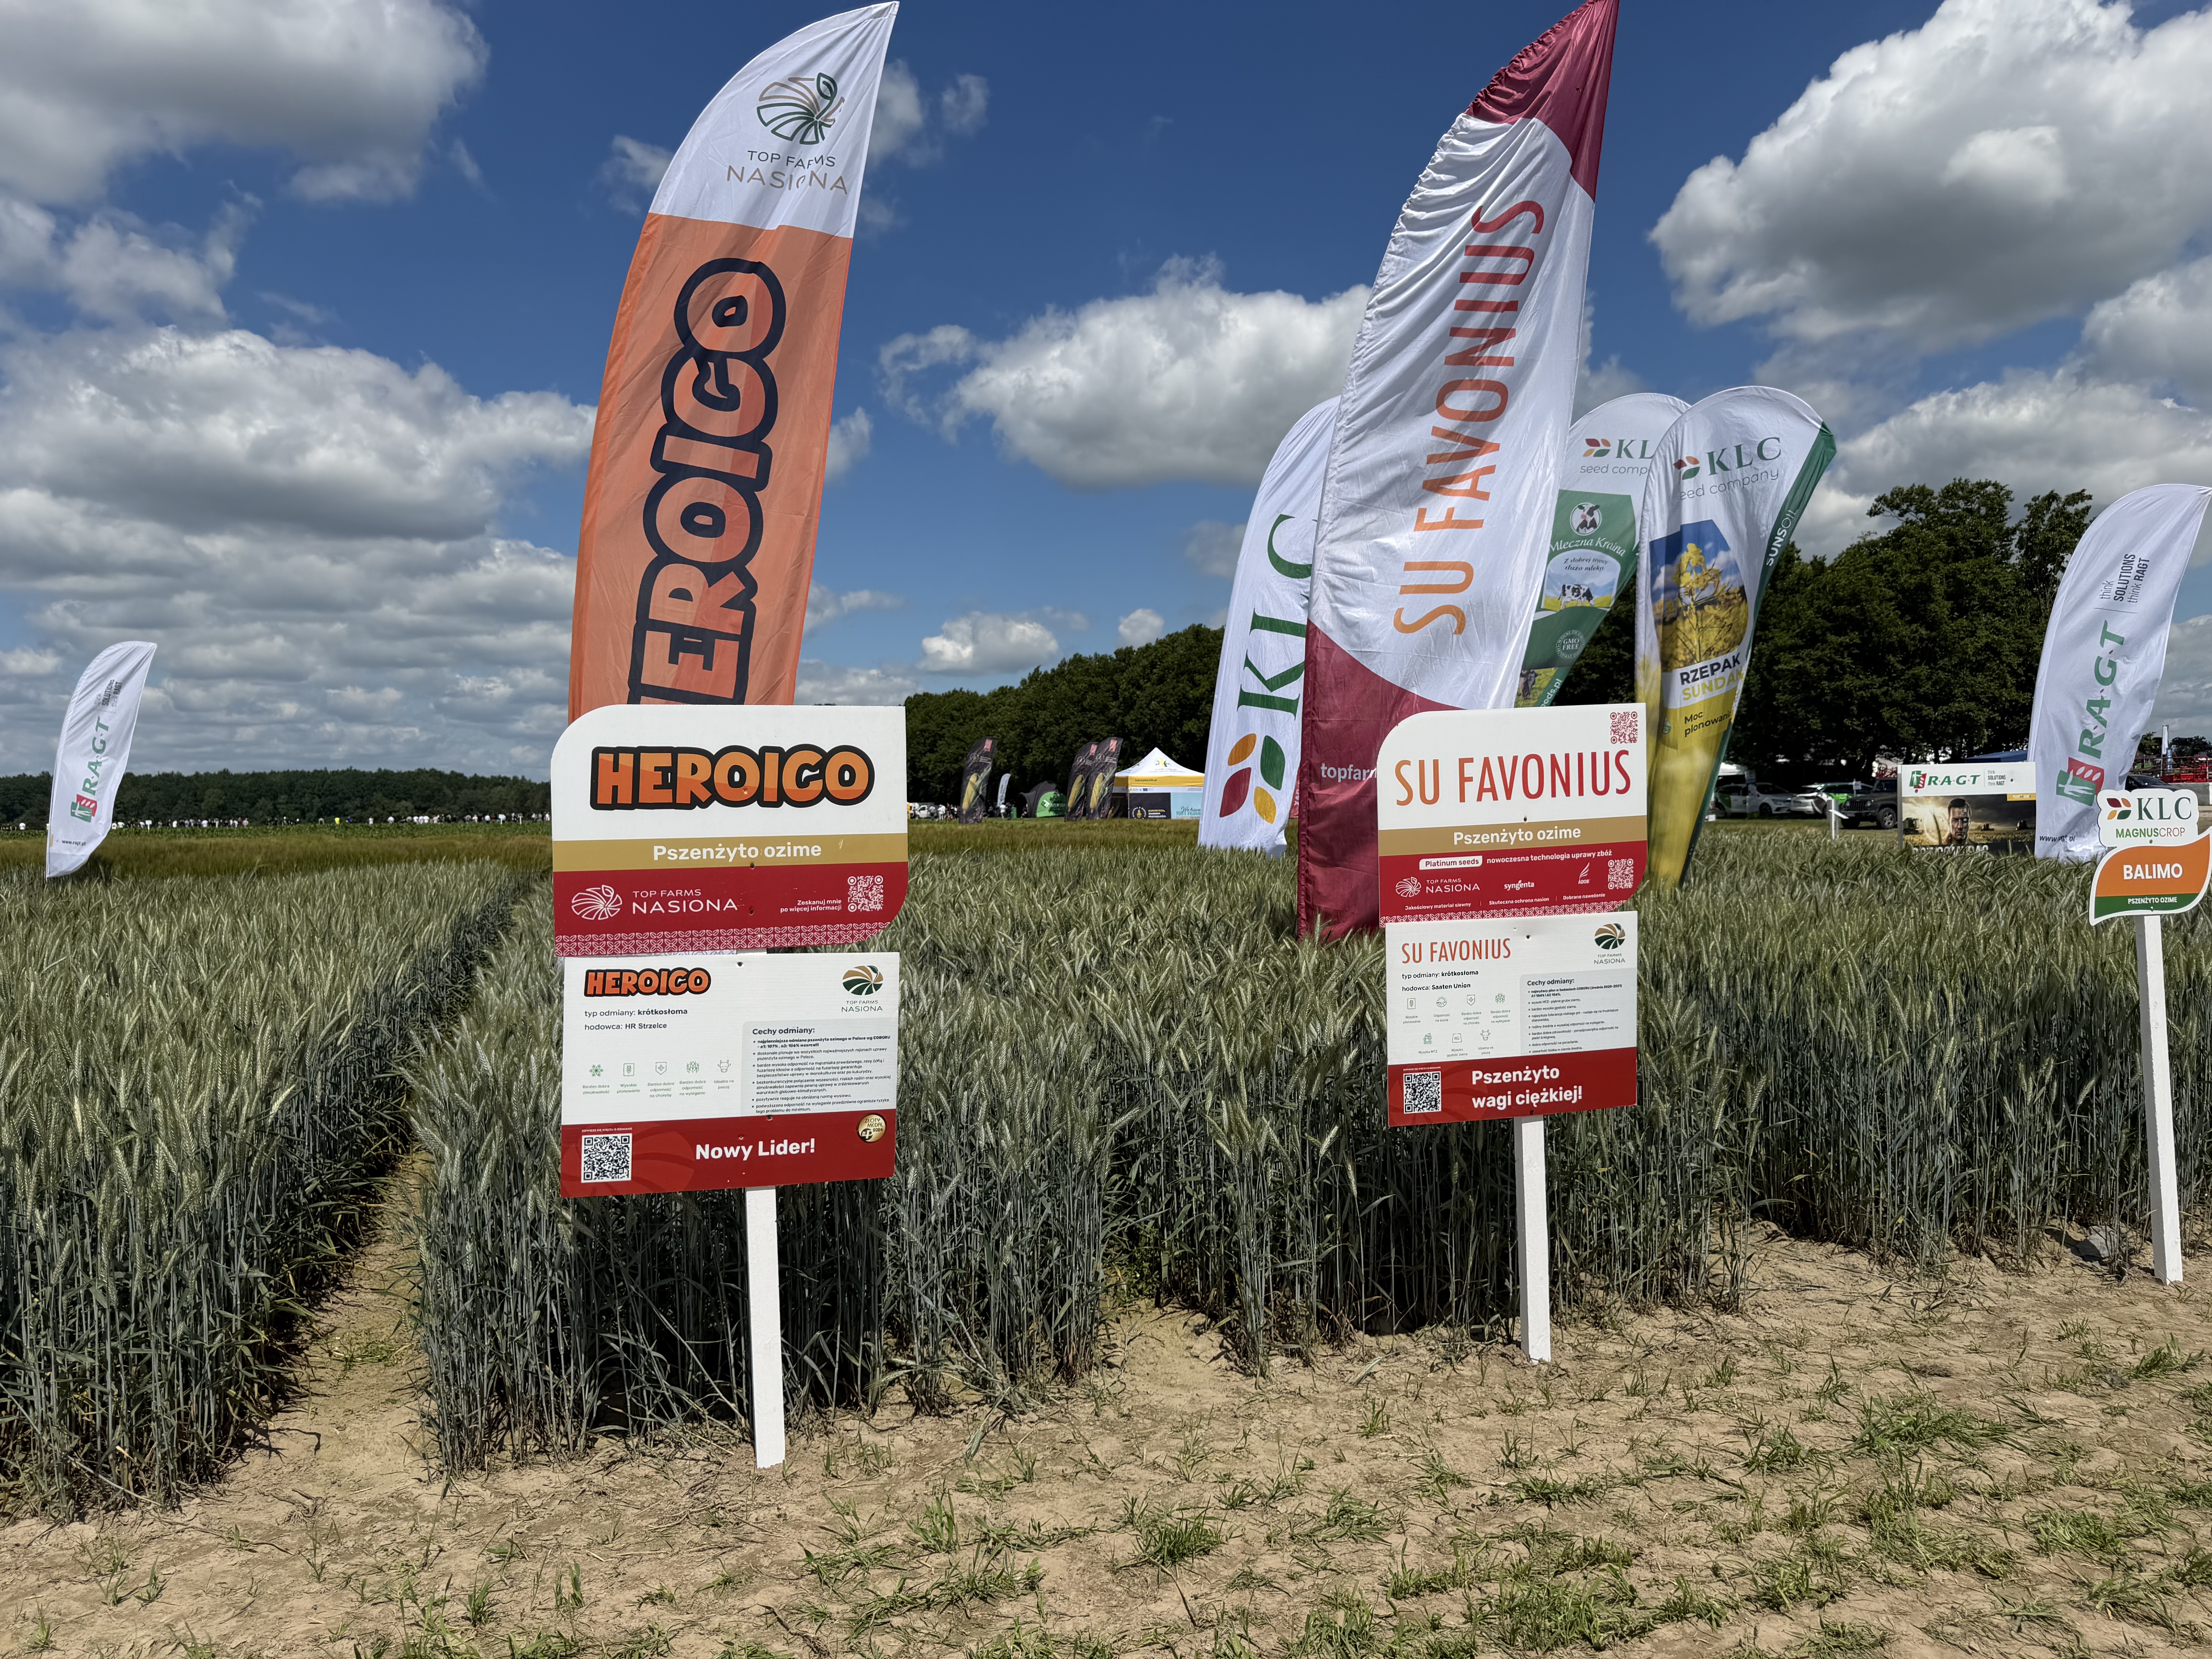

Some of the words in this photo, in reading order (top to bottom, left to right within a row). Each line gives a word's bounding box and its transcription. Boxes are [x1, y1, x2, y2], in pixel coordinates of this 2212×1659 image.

[748, 150, 780, 163] TOP
[1415, 199, 1545, 532] FAVONIUS
[1616, 439, 1653, 459] KL
[1705, 437, 1781, 476] KLC
[1580, 464, 1608, 474] seed
[1612, 466, 1650, 476] comp
[627, 257, 786, 705] EROICO
[1680, 486, 1704, 500] eed
[1710, 469, 1779, 495] company
[1549, 539, 1594, 552] Mleczna
[1595, 537, 1626, 557] Kraina
[1766, 508, 1798, 566] SUNSOIL
[2114, 554, 2136, 601] SOLUTIONS
[2134, 557, 2150, 582] RAGT
[1394, 560, 1474, 636] SU
[2100, 580, 2114, 600] think
[2128, 583, 2142, 603] think
[1680, 652, 1740, 685] RZEPAK
[1685, 712, 1703, 724] Moc
[590, 744, 875, 810] HEROICO
[1395, 759, 1439, 806] SU
[1458, 750, 1631, 802] FAVONIUS
[2137, 797, 2192, 821] KLC
[1454, 828, 1533, 845] Pszenżyto
[1537, 826, 1580, 840] ozime
[2116, 828, 2185, 838] MAGNUSCROP
[653, 843, 759, 862] Pszenżyto
[764, 842, 821, 857] ozime
[1530, 852, 1570, 860] technologia
[2124, 864, 2183, 880] BALIMO
[661, 889, 701, 897] FARMS
[1426, 883, 1480, 893] NASIONA
[1504, 880, 1534, 890] syngenta
[632, 898, 737, 914] NASIONA
[2128, 896, 2159, 905] PSZENŻYTO
[1402, 943, 1422, 964] SU
[1430, 938, 1510, 962] FAVONIUS
[585, 968, 711, 996] HEROICO
[1472, 1065, 1559, 1084] Pszenżyto
[1472, 1091, 1511, 1110] wagi
[1516, 1085, 1582, 1107] ciężkiej!
[696, 1143, 753, 1161] Nowy
[758, 1138, 814, 1156] Lider!
